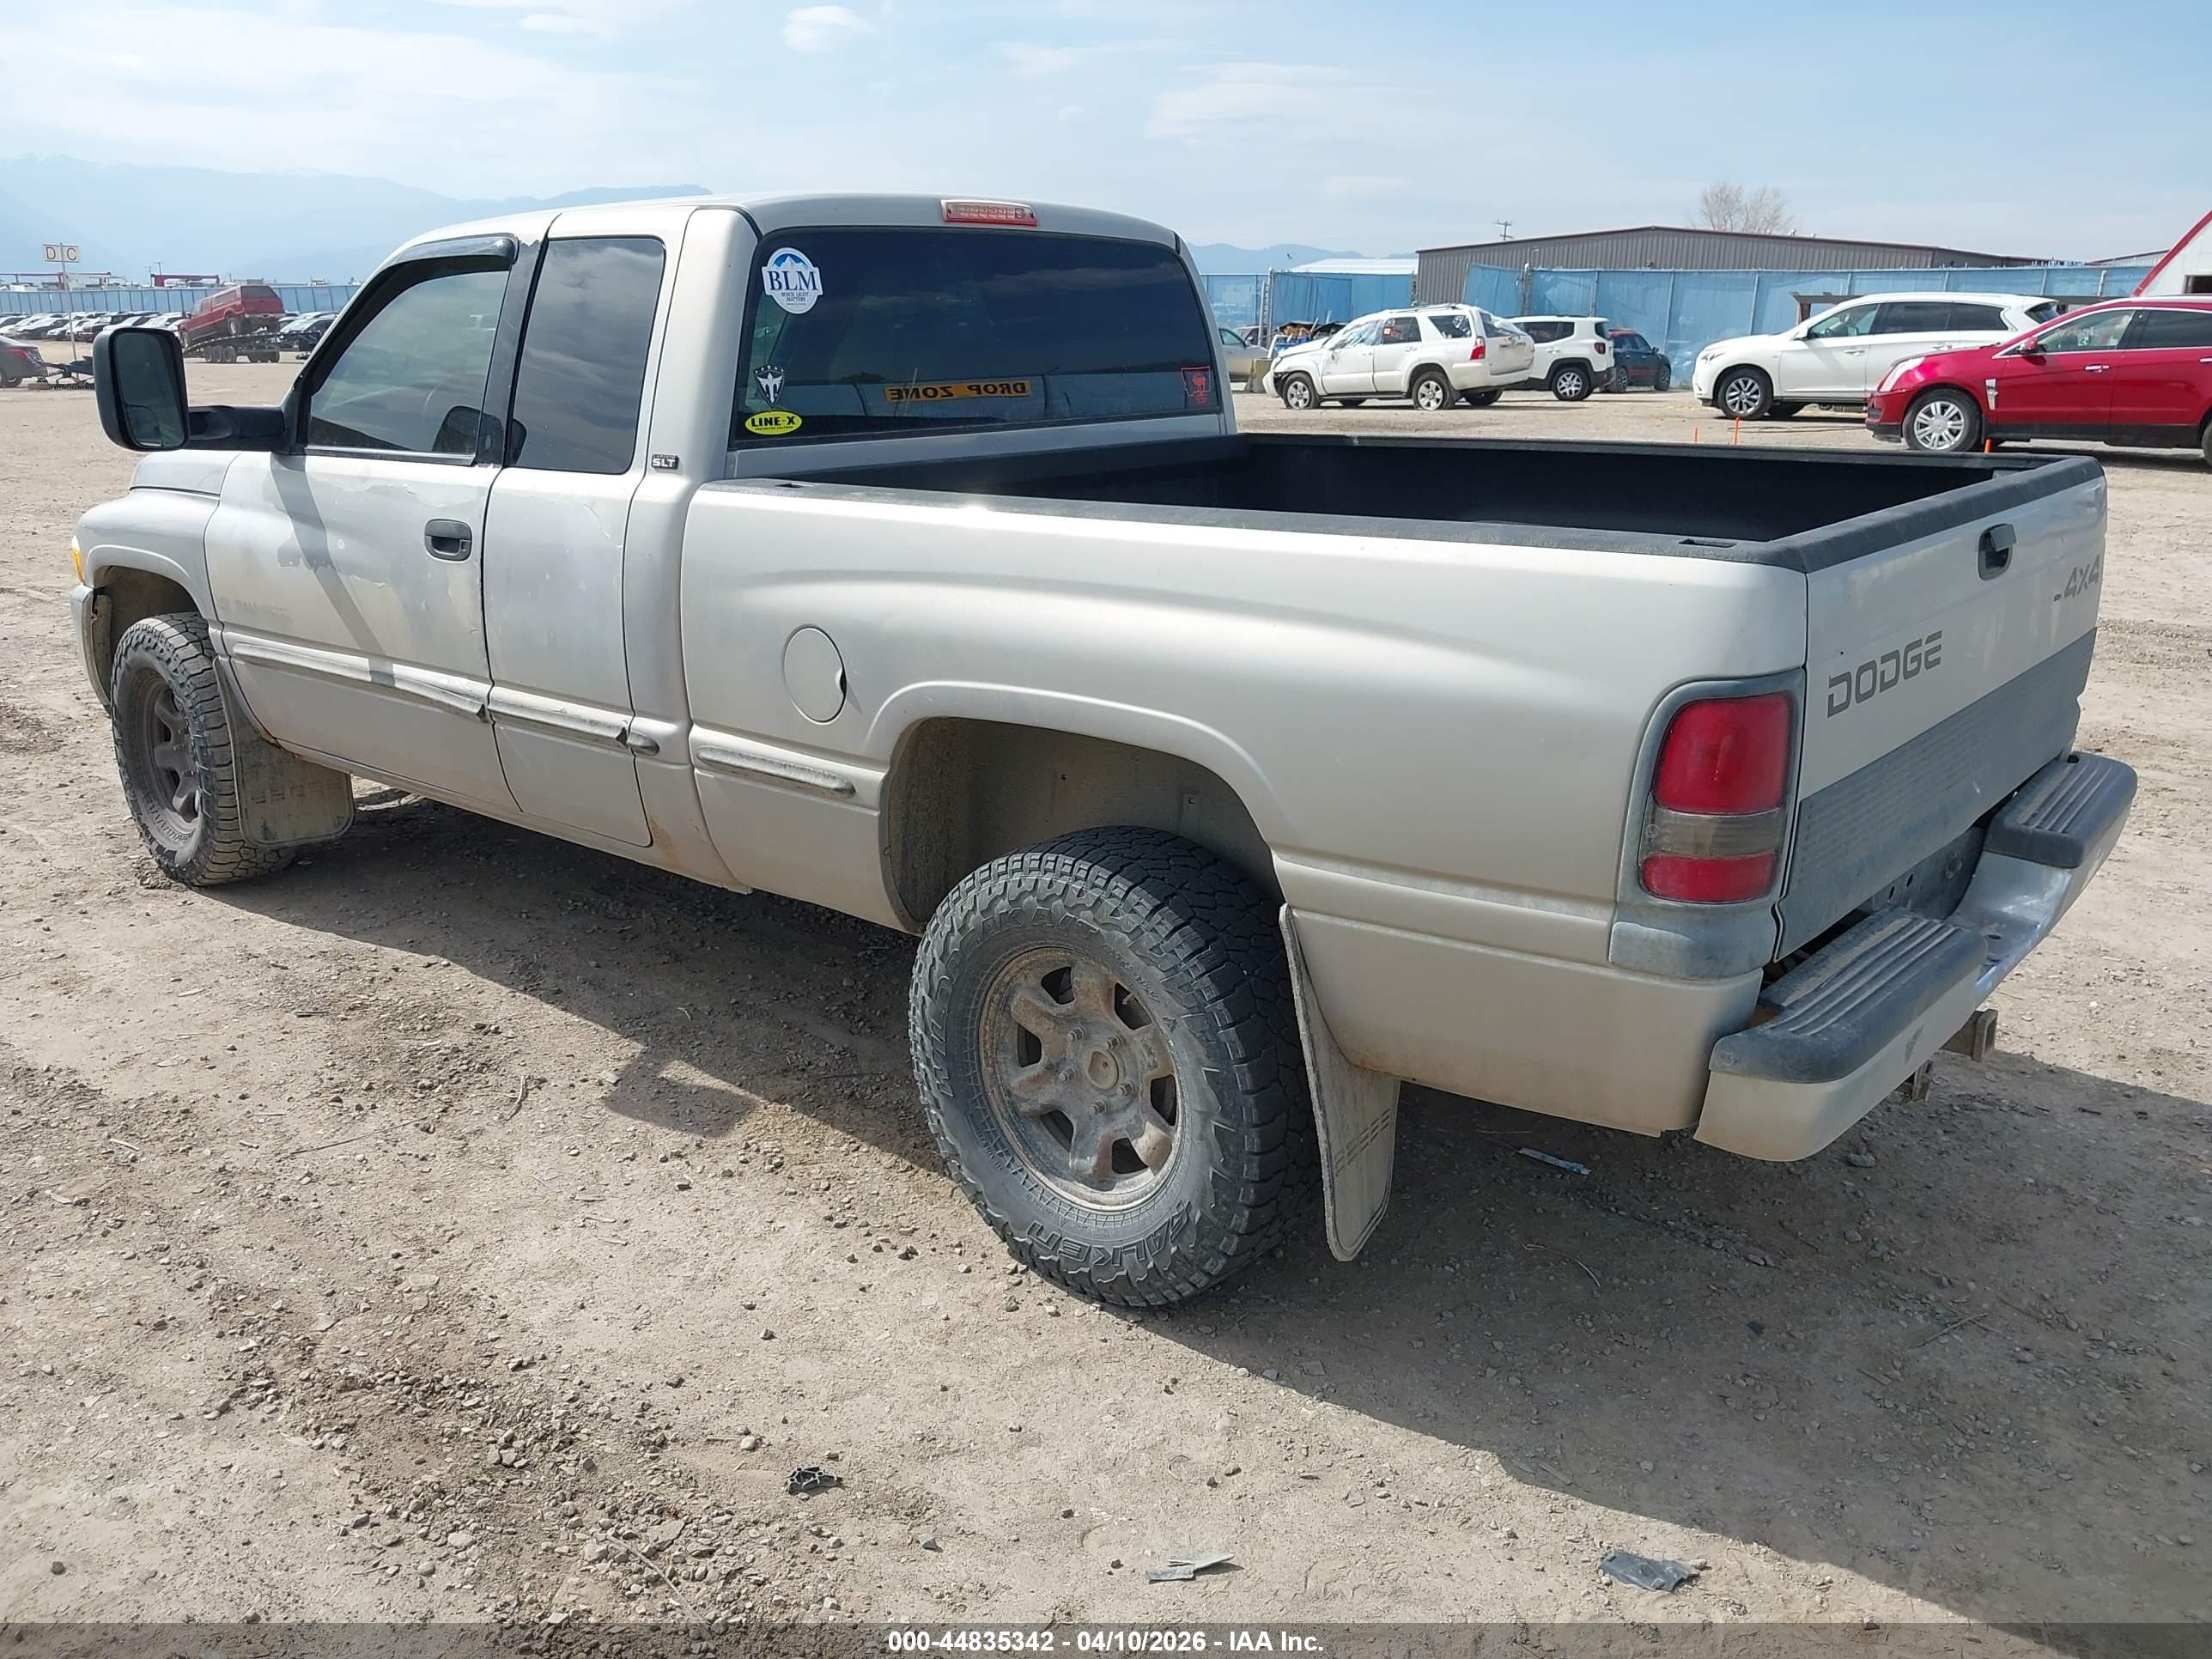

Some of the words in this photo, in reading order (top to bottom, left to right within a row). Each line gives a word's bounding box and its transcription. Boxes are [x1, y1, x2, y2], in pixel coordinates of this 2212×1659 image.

[46, 246, 56, 259] D
[66, 247, 76, 261] C
[768, 270, 818, 291] BLM
[750, 416, 796, 428] LINE-X
[652, 458, 676, 468] SLT
[1826, 629, 1943, 719] DODGE
[1026, 1200, 1193, 1267] FALKEN
